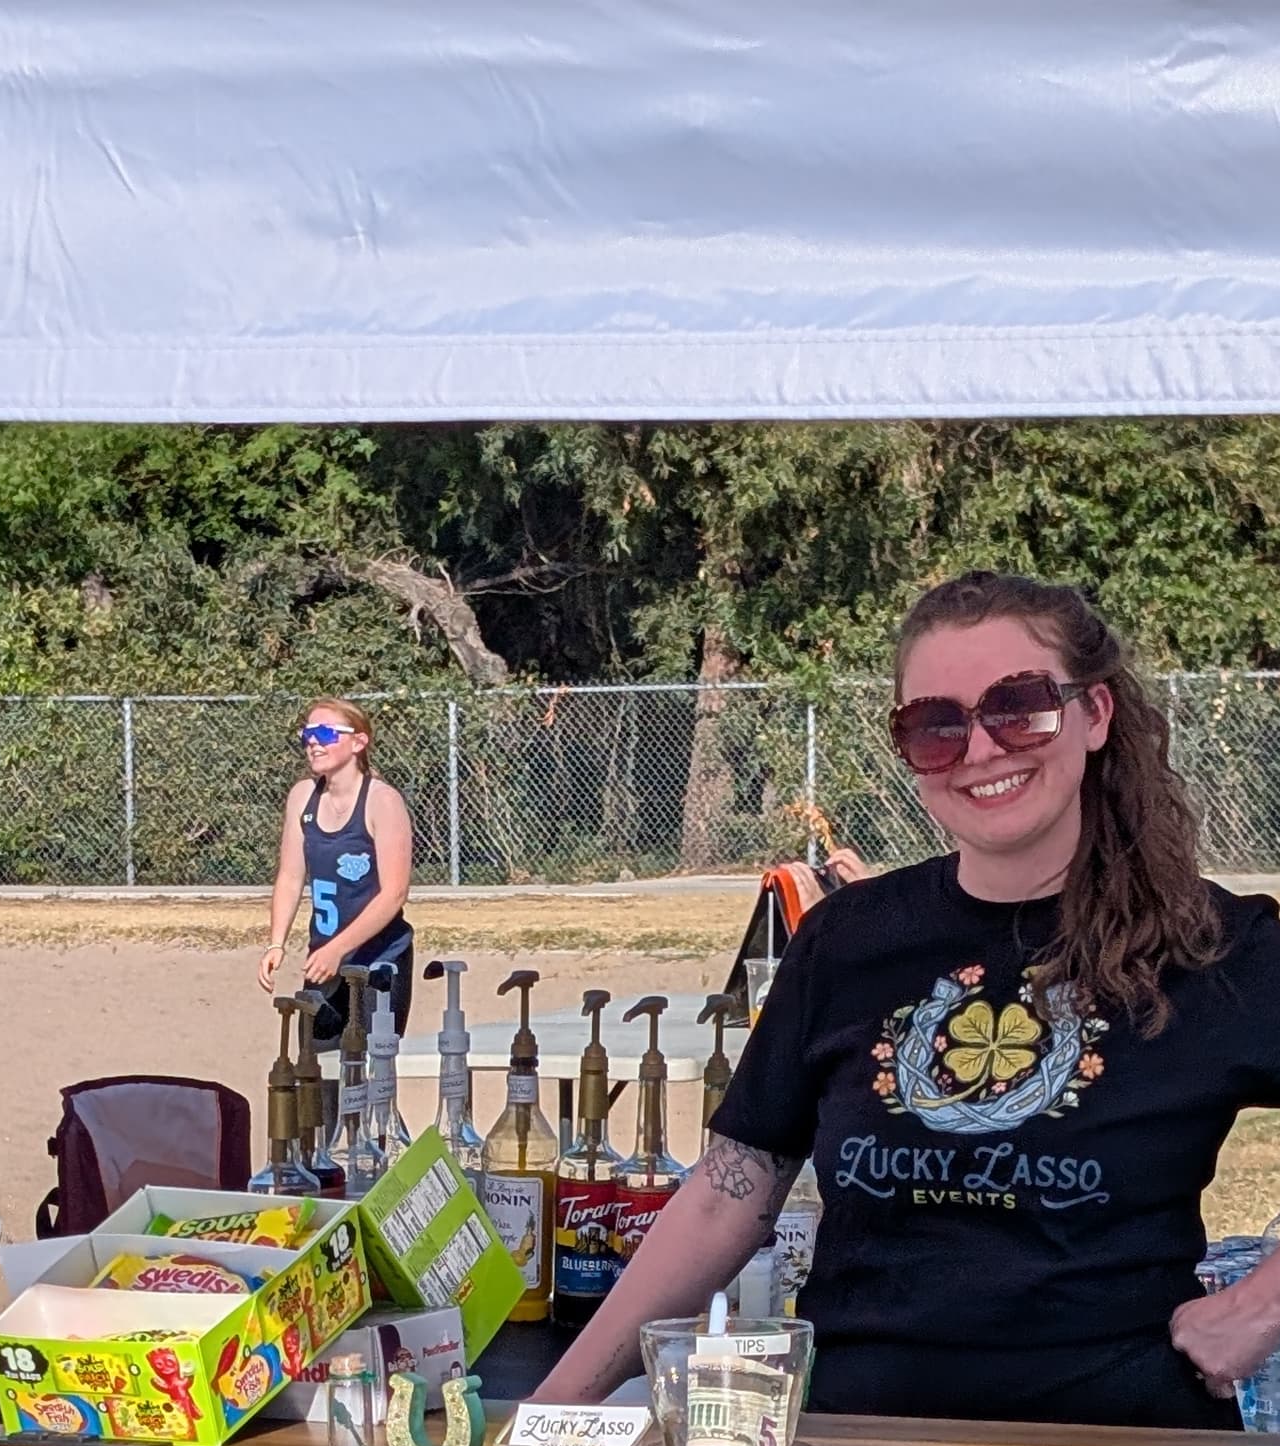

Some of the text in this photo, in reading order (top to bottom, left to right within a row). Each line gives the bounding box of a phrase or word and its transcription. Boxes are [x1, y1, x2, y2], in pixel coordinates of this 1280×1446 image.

[313, 879, 338, 937] 5
[836, 1135, 1104, 1198] LUCKY LASSO
[913, 1189, 1017, 1210] EVENTS
[177, 1213, 257, 1238] SOUR
[774, 1231, 806, 1242] NIN
[329, 1223, 350, 1259] 18
[735, 1339, 766, 1354] TIPS
[0, 1347, 36, 1372] 18
[520, 1415, 635, 1442] LUCKY LASSO
